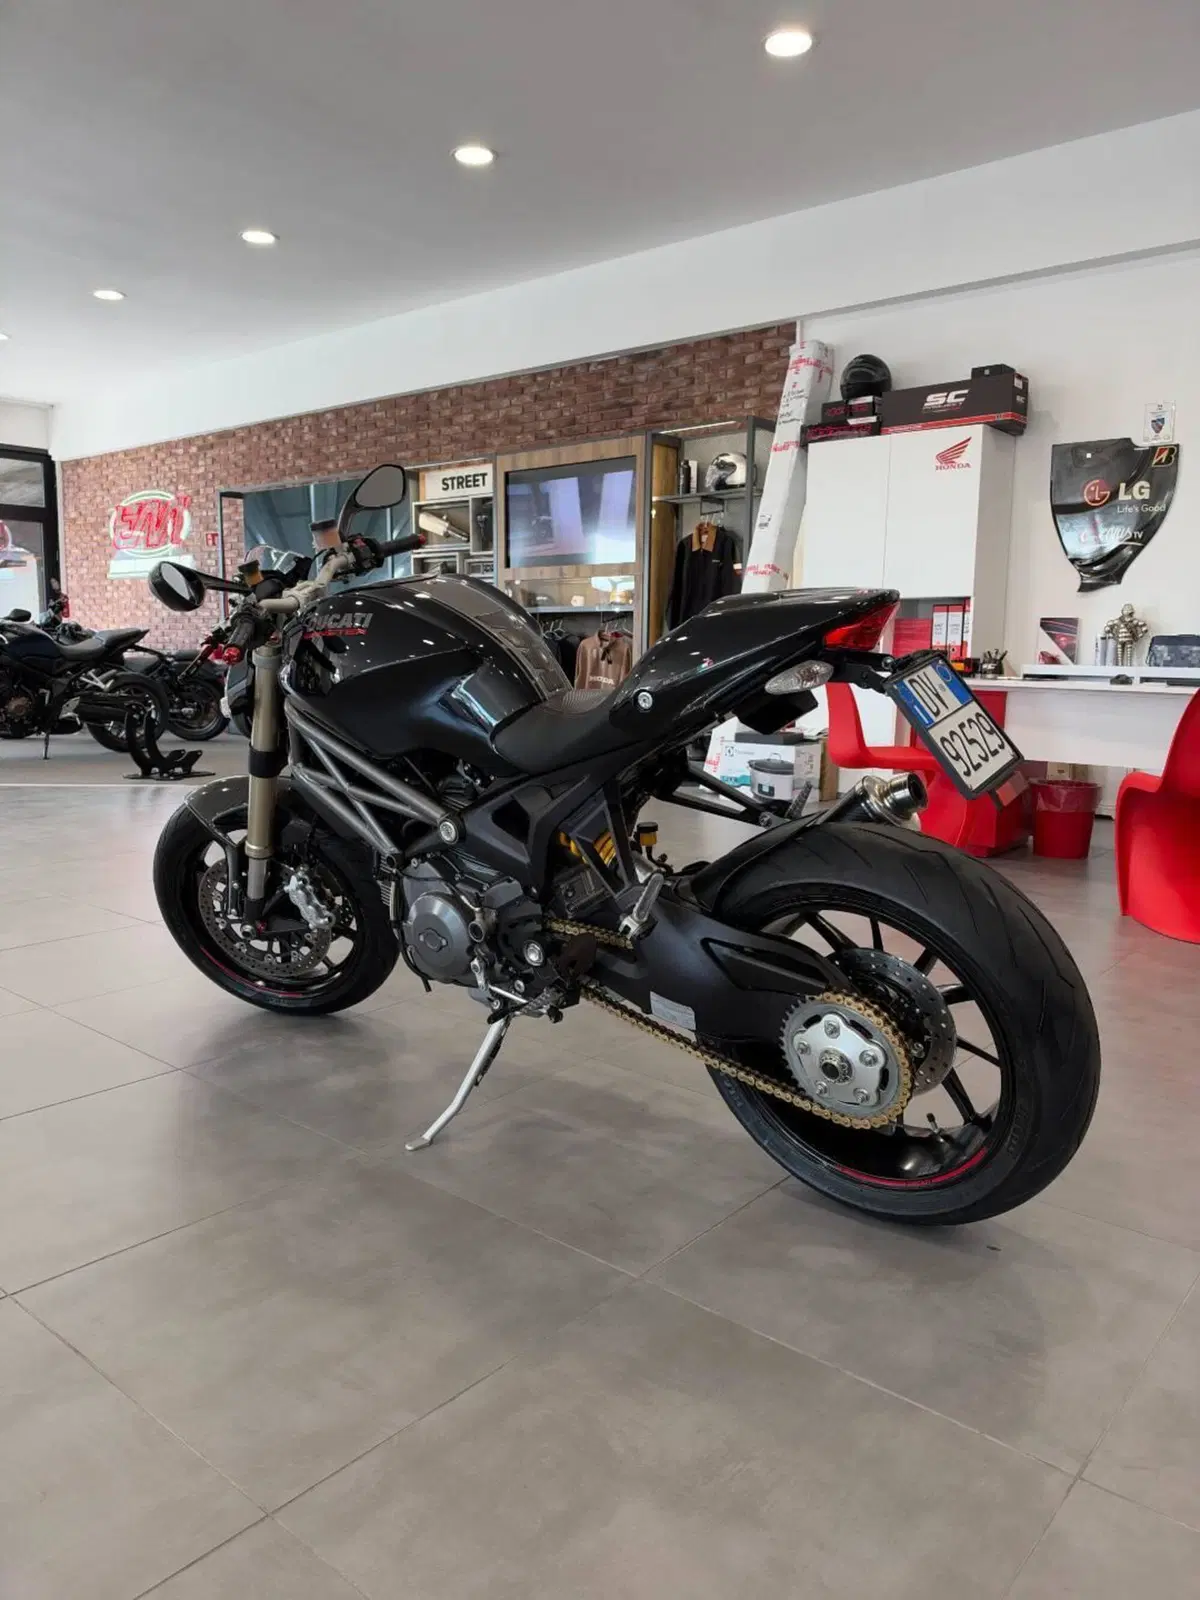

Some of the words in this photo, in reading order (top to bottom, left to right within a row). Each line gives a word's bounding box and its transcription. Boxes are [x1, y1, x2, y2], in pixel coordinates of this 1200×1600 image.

[923, 390, 969, 407] SC
[935, 463, 972, 471] HONDA
[441, 473, 488, 491] STREET
[1118, 480, 1151, 501] LG
[1117, 505, 1140, 513] Life's
[1141, 503, 1167, 512] Good
[908, 672, 949, 717] DV
[939, 712, 1006, 777] 92529
